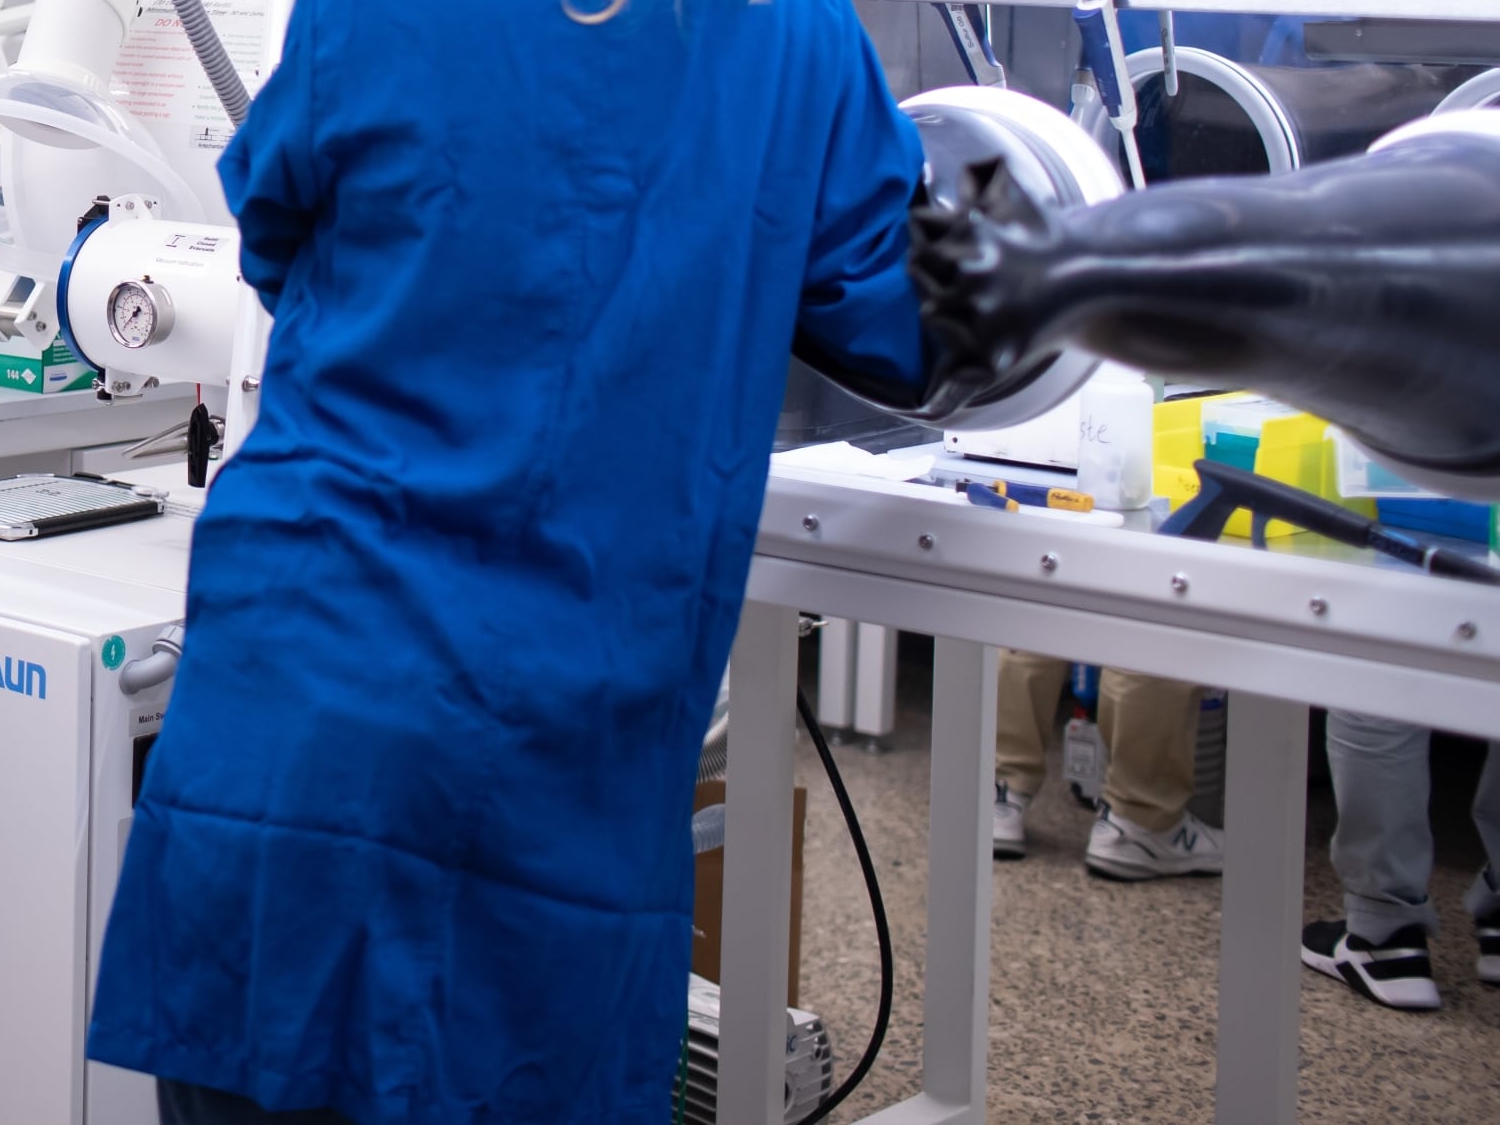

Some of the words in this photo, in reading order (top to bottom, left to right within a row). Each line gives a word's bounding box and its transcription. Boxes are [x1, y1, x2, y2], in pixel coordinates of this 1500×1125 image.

[154, 18, 171, 27] DO
[6, 369, 20, 380] 144
[1079, 414, 1111, 444] ste
[138, 714, 154, 724] Main
